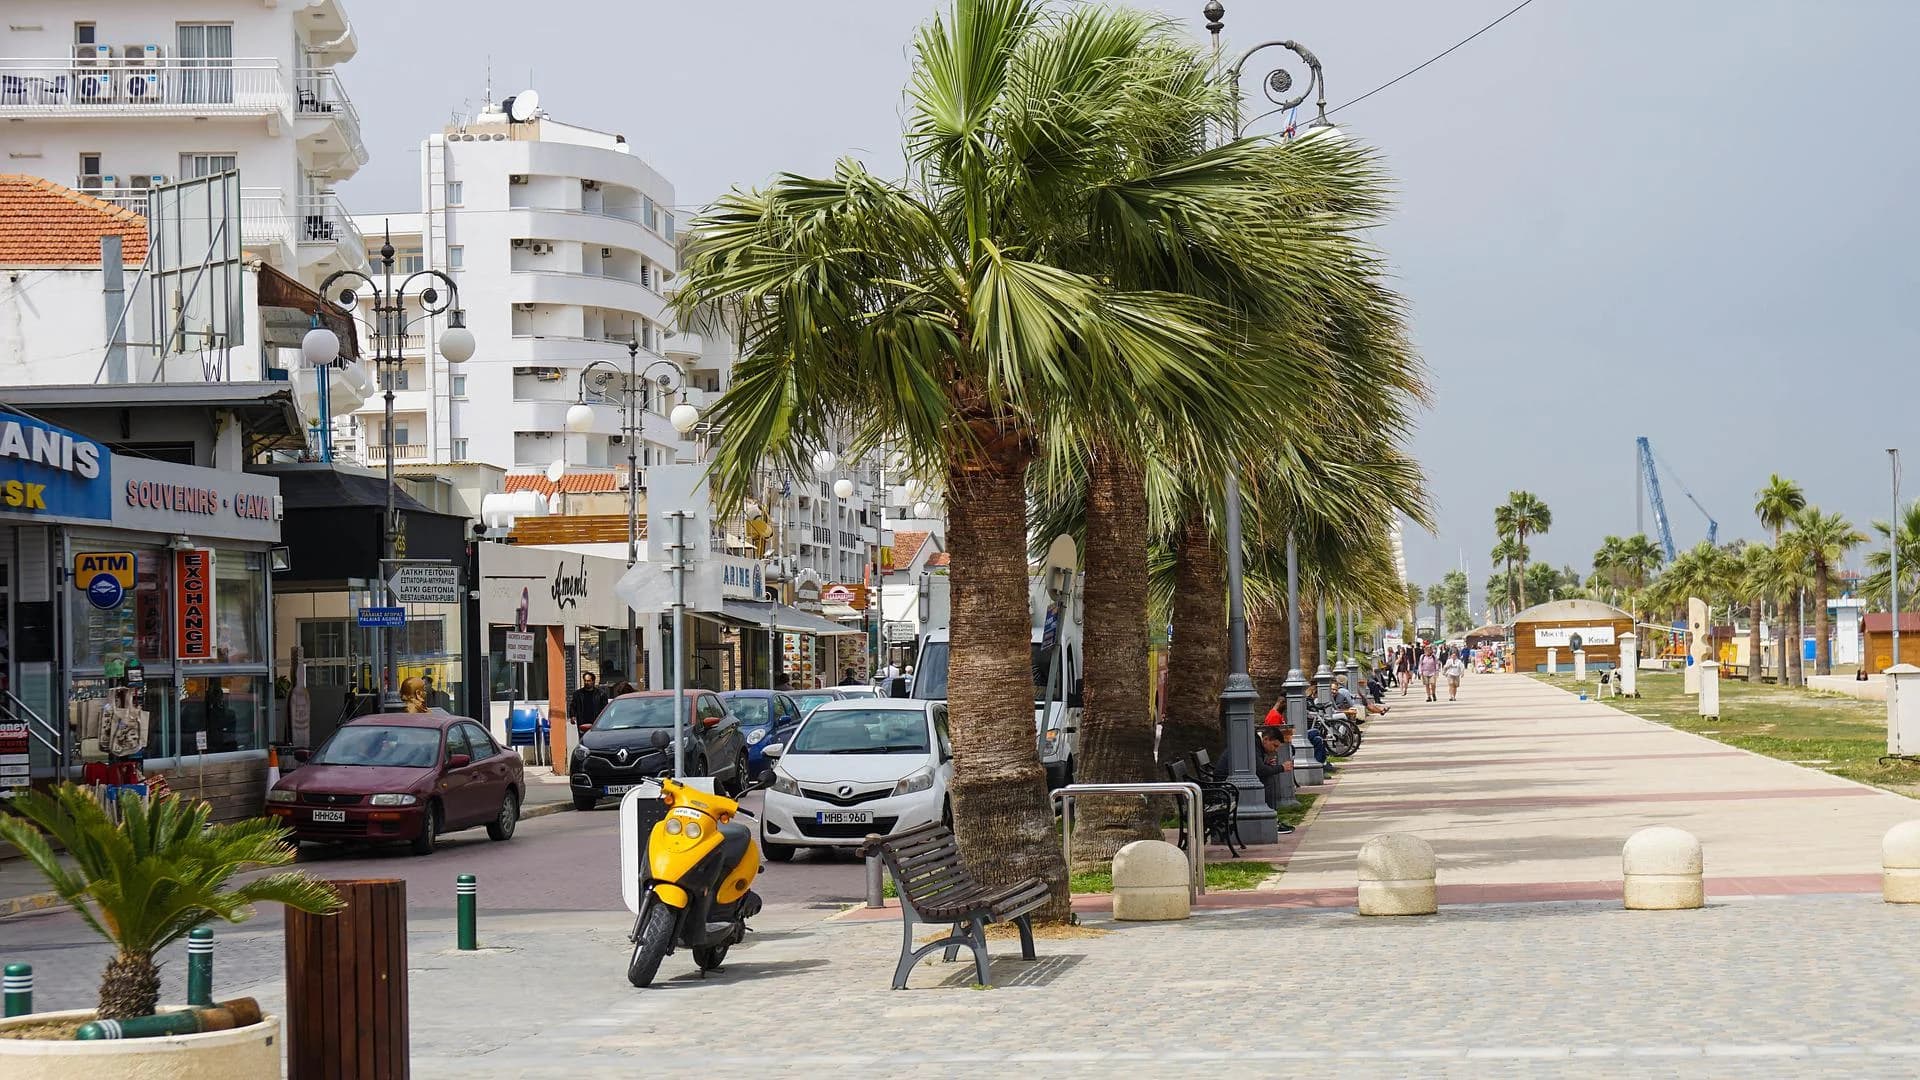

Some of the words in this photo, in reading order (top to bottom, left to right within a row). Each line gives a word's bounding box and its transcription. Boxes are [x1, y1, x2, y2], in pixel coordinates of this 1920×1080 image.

[0, 421, 100, 479] ANIS
[0, 479, 46, 510] SK
[127, 479, 218, 515] SOUVENIRS
[235, 492, 270, 520] CAVA
[82, 556, 128, 571] ATM
[723, 564, 750, 588] ARINE
[184, 554, 203, 655] EXCHANGE
[314, 811, 343, 821] HHH264
[824, 813, 843, 823] MHB
